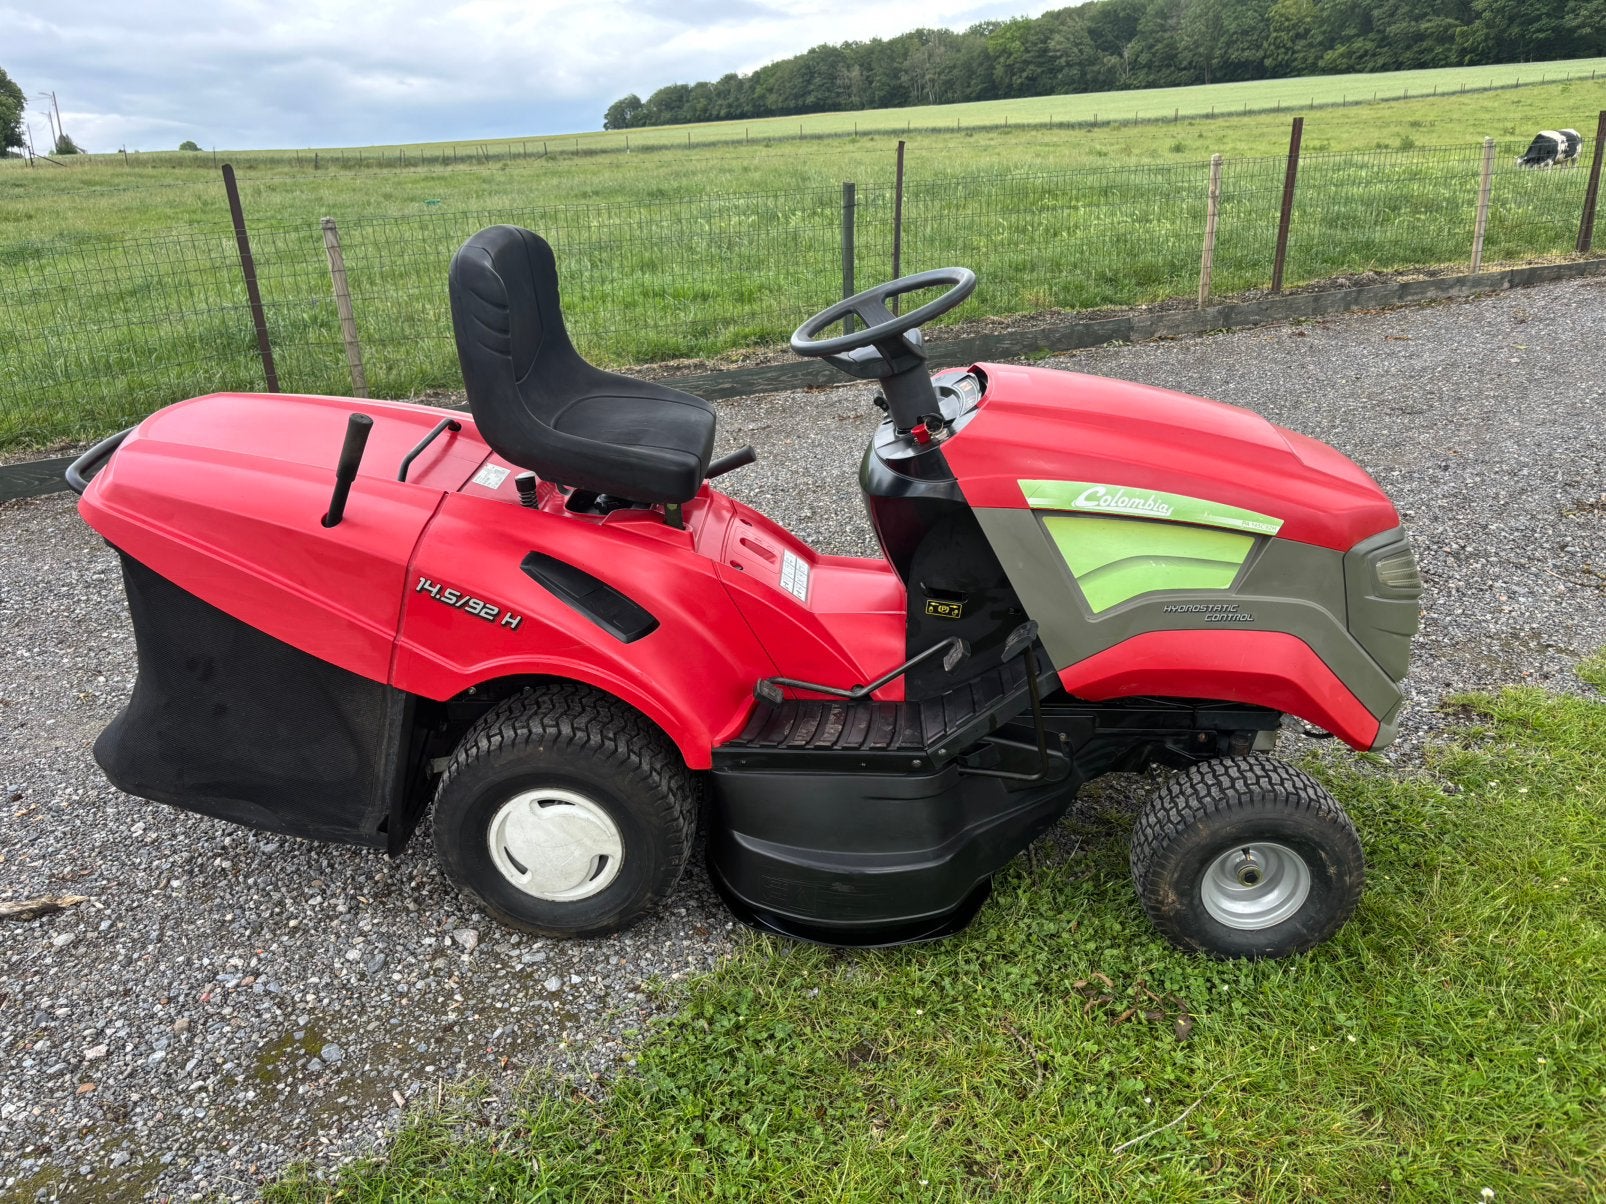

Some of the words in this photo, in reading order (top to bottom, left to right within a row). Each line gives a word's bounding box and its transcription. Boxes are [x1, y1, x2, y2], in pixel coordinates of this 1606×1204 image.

[1072, 485, 1174, 516] Colombia
[416, 577, 499, 620] 14.5/92
[501, 612, 521, 629] H
[1163, 604, 1239, 613] HYDROSTATIC
[1204, 613, 1254, 622] CONTROL
